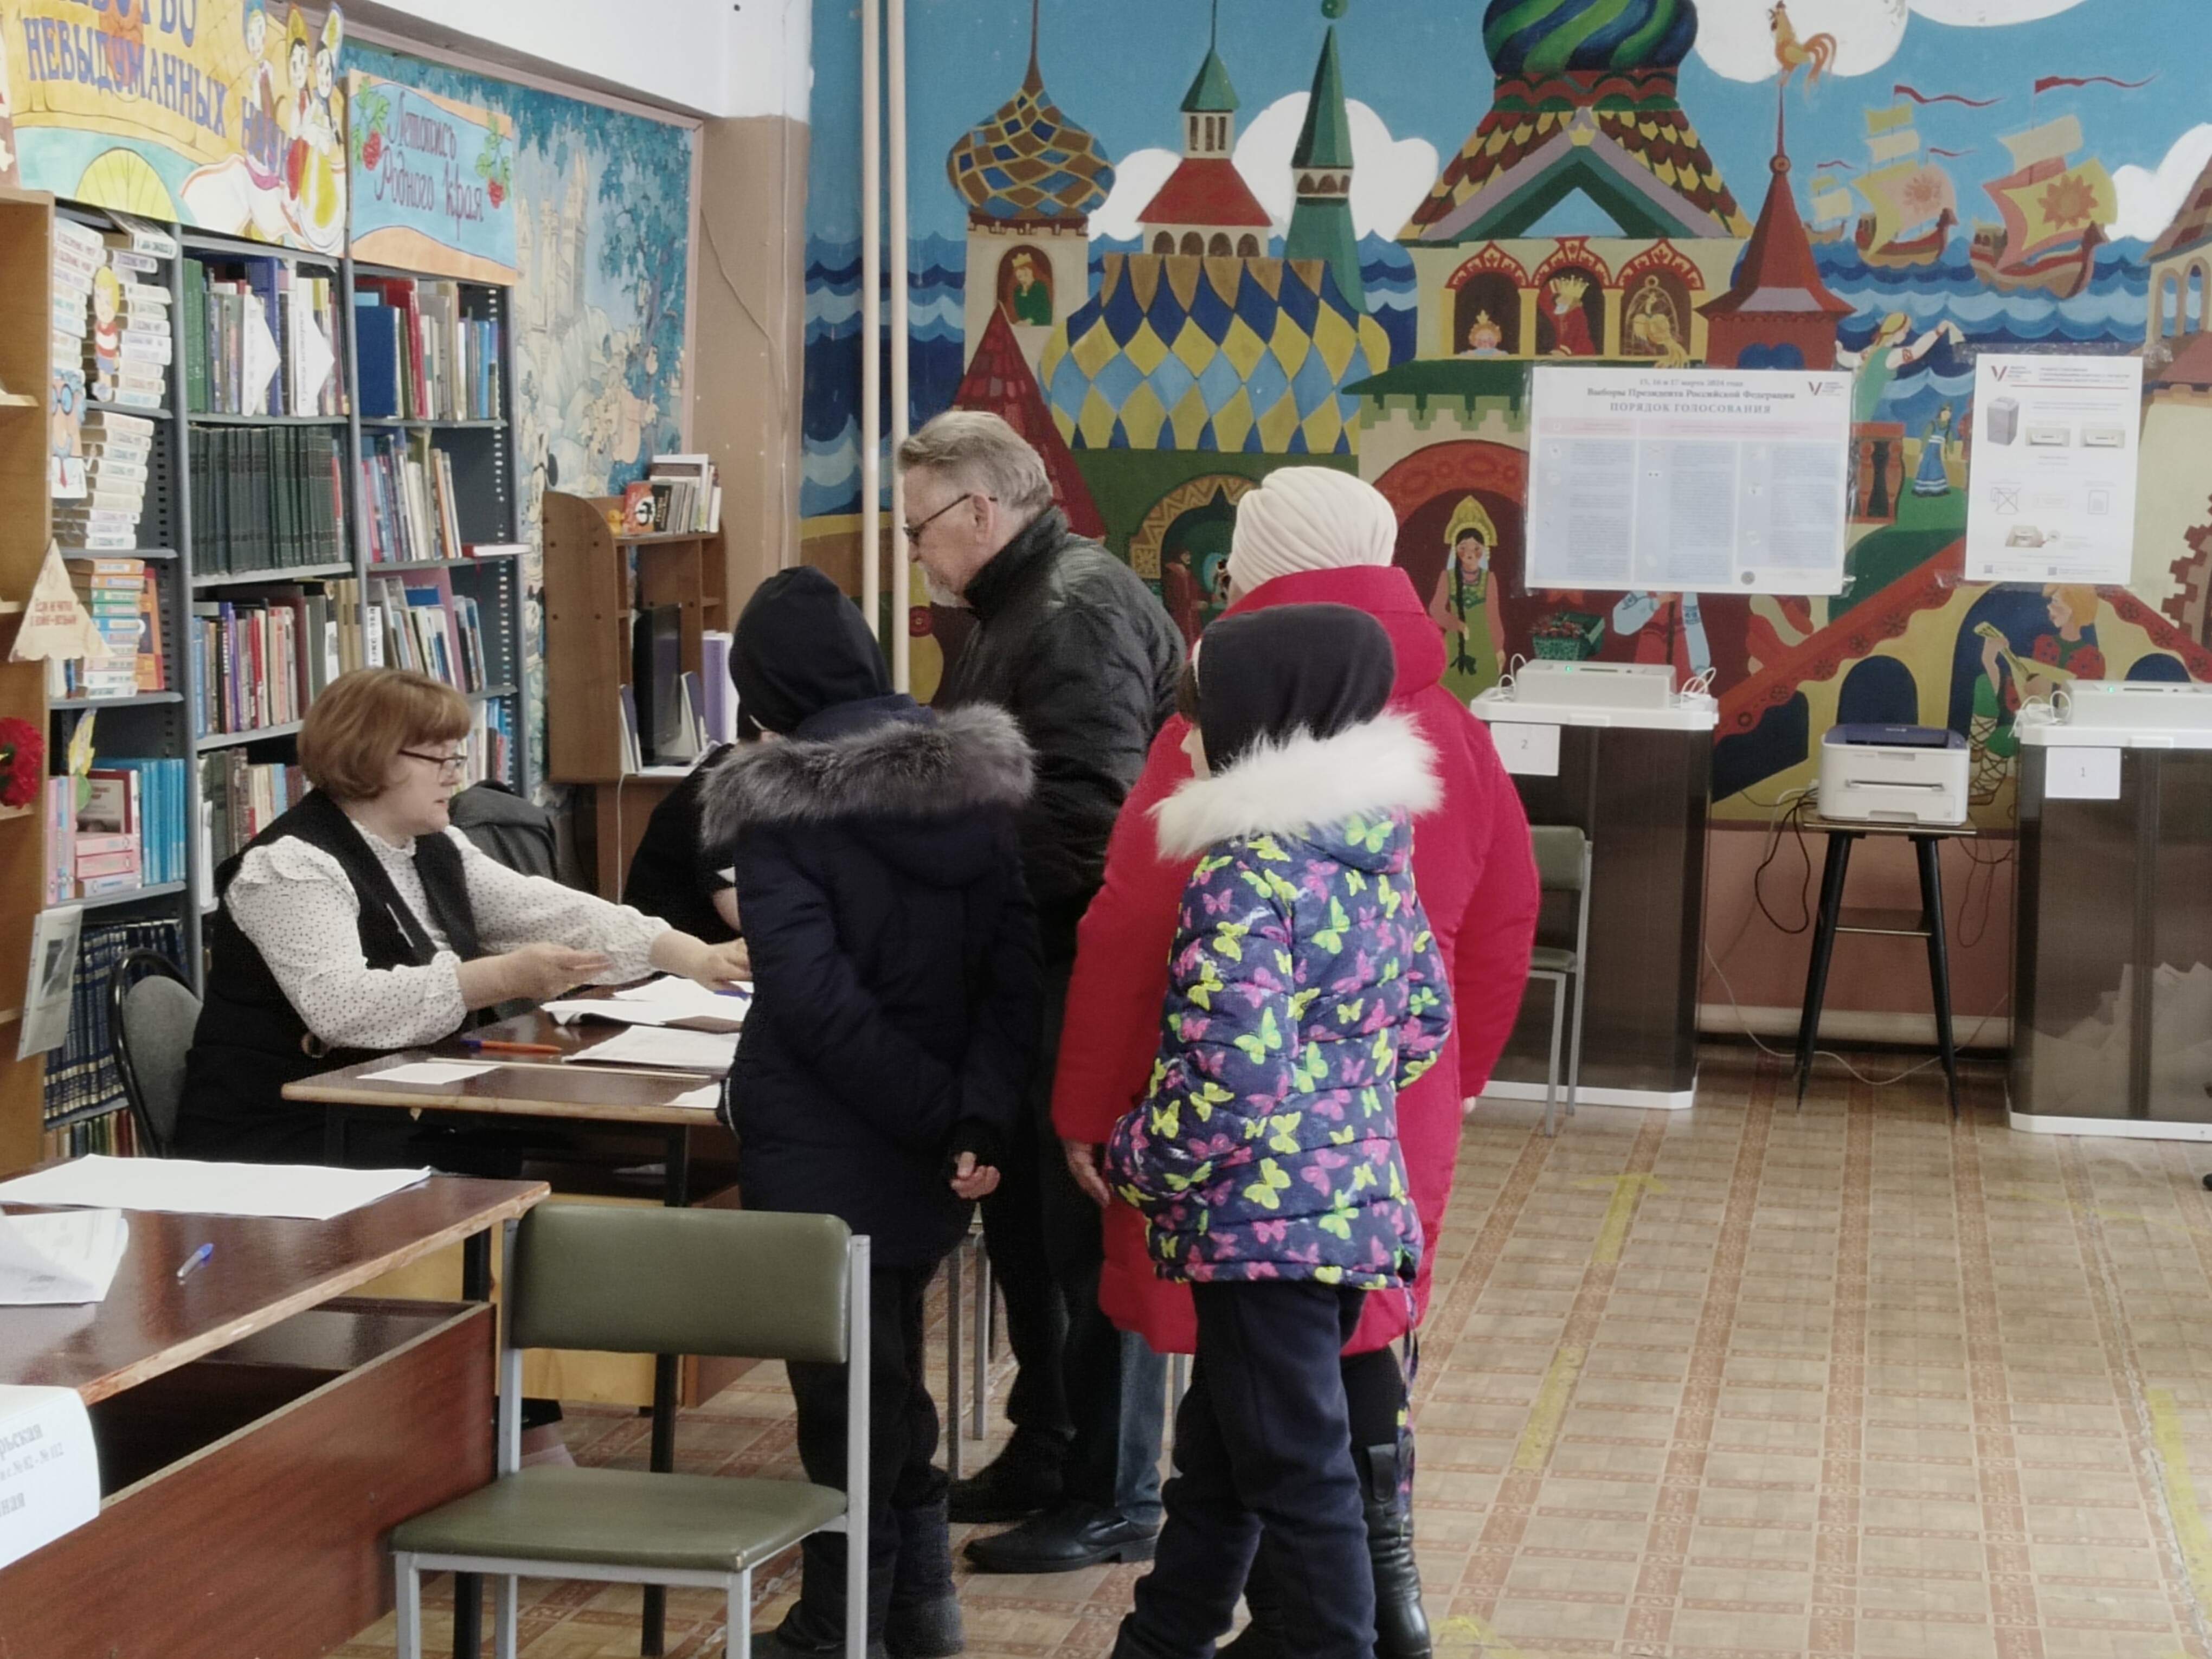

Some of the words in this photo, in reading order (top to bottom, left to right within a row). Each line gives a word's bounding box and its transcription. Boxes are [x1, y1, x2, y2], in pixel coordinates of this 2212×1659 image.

[23, 17, 228, 138] НЕВЫДУМАННЫХ
[388, 91, 456, 160] Летопись
[374, 145, 434, 211] Родного
[1587, 388, 1625, 398] Выборы
[1628, 388, 1683, 399] Президента
[1686, 389, 1739, 398] Российской
[1742, 390, 1795, 401] Федерации
[1610, 402, 1670, 413] ПОРЯДОК
[1674, 403, 1771, 414] ГОЛОСОВАНИЯ
[1521, 740, 1528, 750] 2
[2080, 767, 2086, 777] 1
